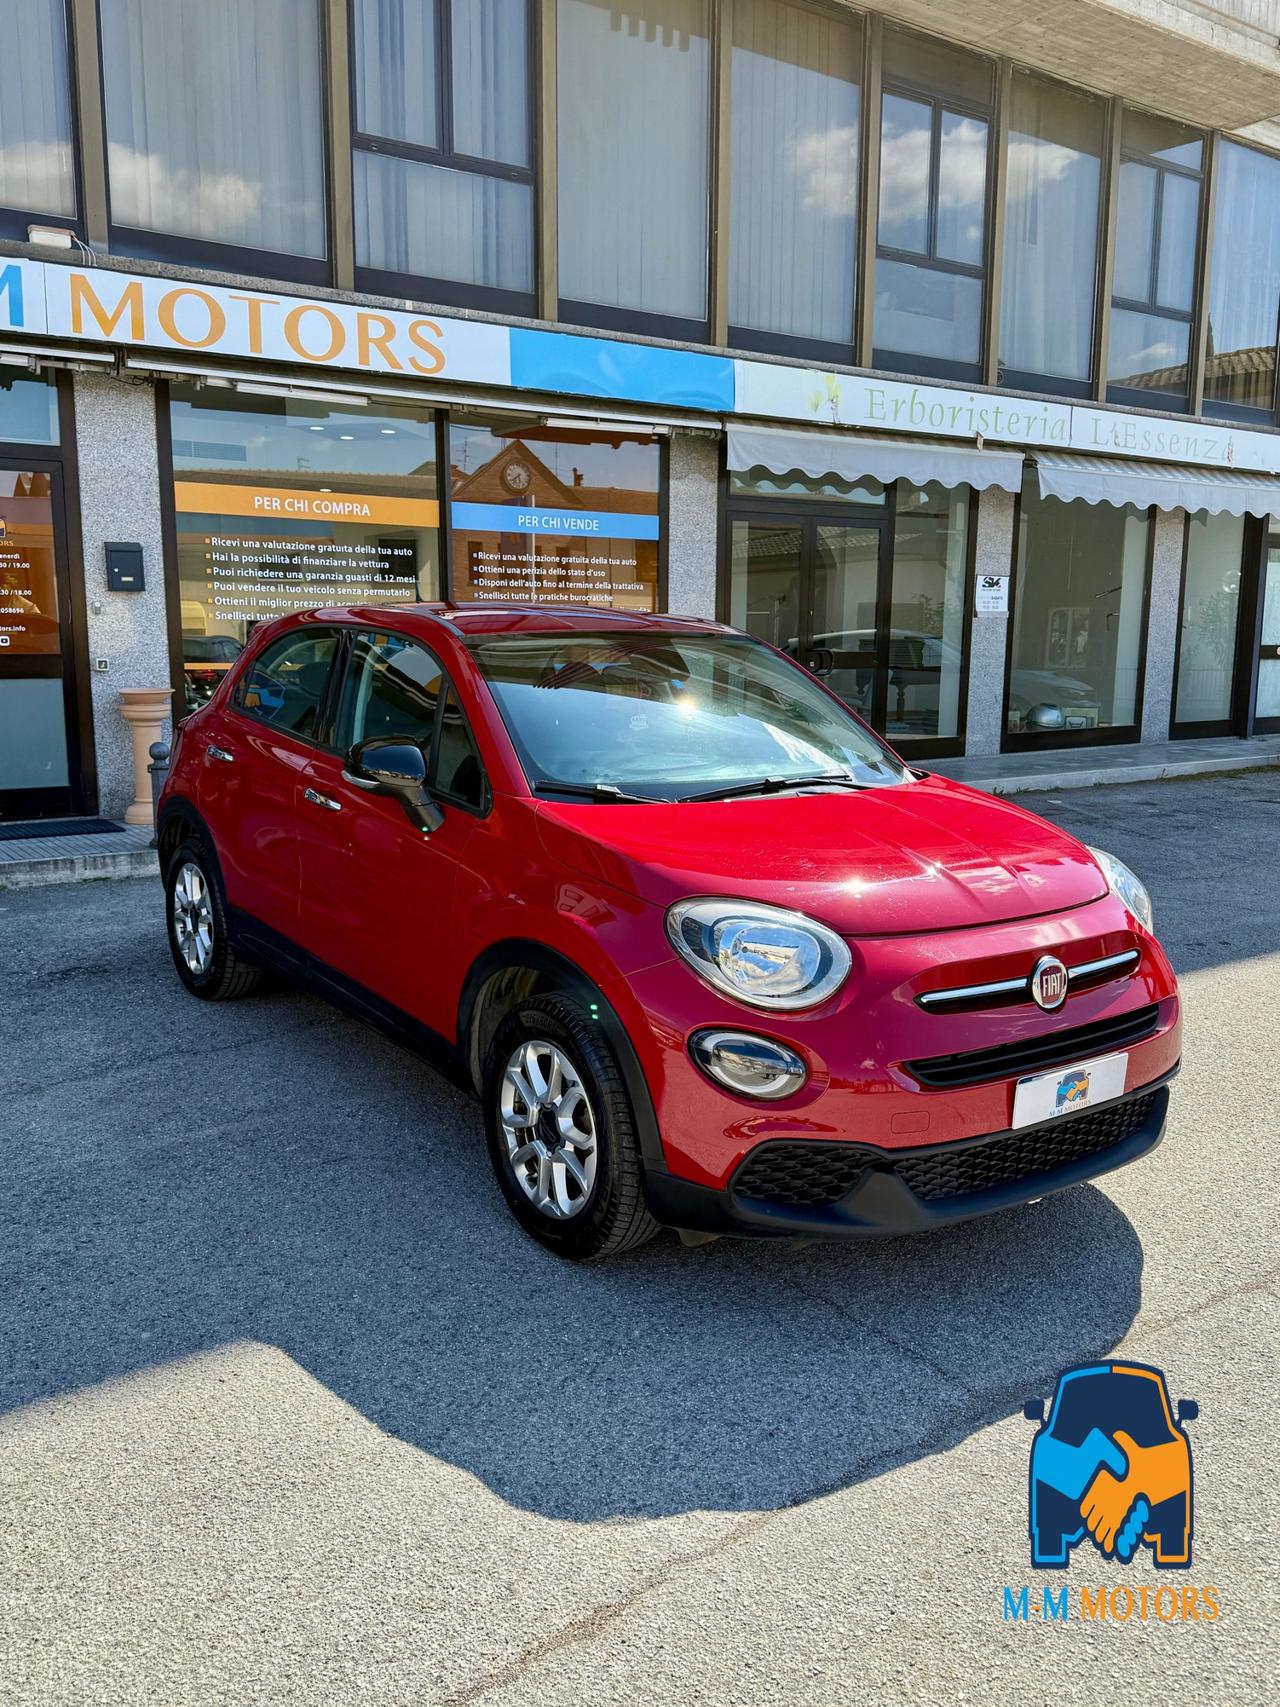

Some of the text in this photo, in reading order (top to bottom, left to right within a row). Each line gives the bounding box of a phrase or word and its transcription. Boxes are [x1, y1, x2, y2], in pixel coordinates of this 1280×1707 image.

[70, 273, 446, 374] MOTORS
[864, 388, 1066, 440] Erboristeria
[254, 496, 370, 516] PER CHI COMPRA
[518, 515, 600, 531] PER CHI VENDE
[212, 537, 240, 546] Ricevi
[242, 540, 260, 548] una
[262, 540, 316, 551] valutazione
[318, 544, 353, 553] gratuita
[355, 545, 375, 554] della
[212, 552, 390, 568] Hai la possibilità di finanziare la vettura
[478, 552, 501, 560] Ricevi
[518, 554, 559, 562] valutazione
[561, 556, 589, 564] gratuita
[213, 567, 234, 576] Puoi
[237, 568, 284, 578] richiedere
[306, 572, 343, 581] garanzia
[345, 574, 372, 582] guasti
[478, 565, 505, 573] Ottieni
[522, 567, 546, 576] perizia
[548, 568, 566, 576] dello
[214, 582, 235, 591] Puoi
[237, 584, 276, 592] vendere
[278, 584, 284, 592] il
[303, 585, 335, 594] veicolo
[363, 588, 410, 597] permutarlo
[478, 578, 508, 588] Disponi
[509, 579, 541, 587] dell'auto
[214, 596, 248, 606] Ottieni
[250, 598, 256, 606] il
[259, 598, 291, 608] miglior
[294, 600, 324, 608] prezzo
[570, 593, 613, 602] burocratiche
[215, 612, 254, 620] Snellisci
[1042, 972, 1061, 997] FIAT
